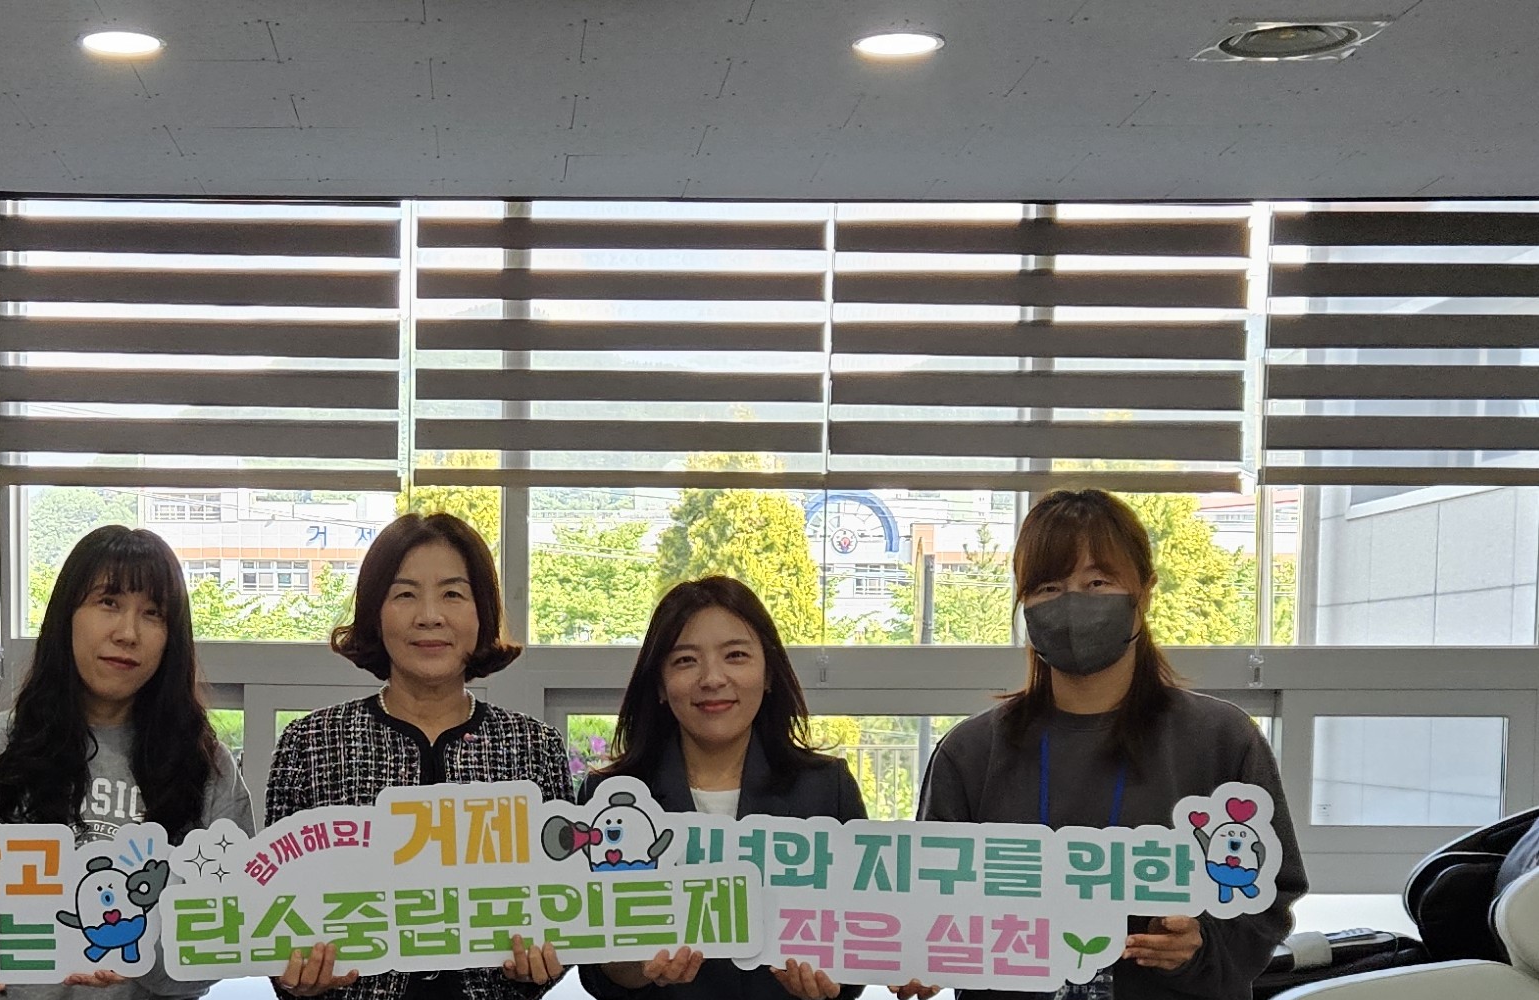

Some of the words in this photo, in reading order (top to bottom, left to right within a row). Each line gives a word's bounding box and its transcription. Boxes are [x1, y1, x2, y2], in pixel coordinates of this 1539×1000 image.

[243, 819, 372, 887] 함께해요!
[389, 795, 530, 867] 거제
[853, 834, 1043, 899] 지구를
[1065, 840, 1196, 904] 위한
[174, 875, 750, 967] 탄소중립포인트제
[778, 908, 903, 972] 작은
[925, 913, 1052, 978] 실천
